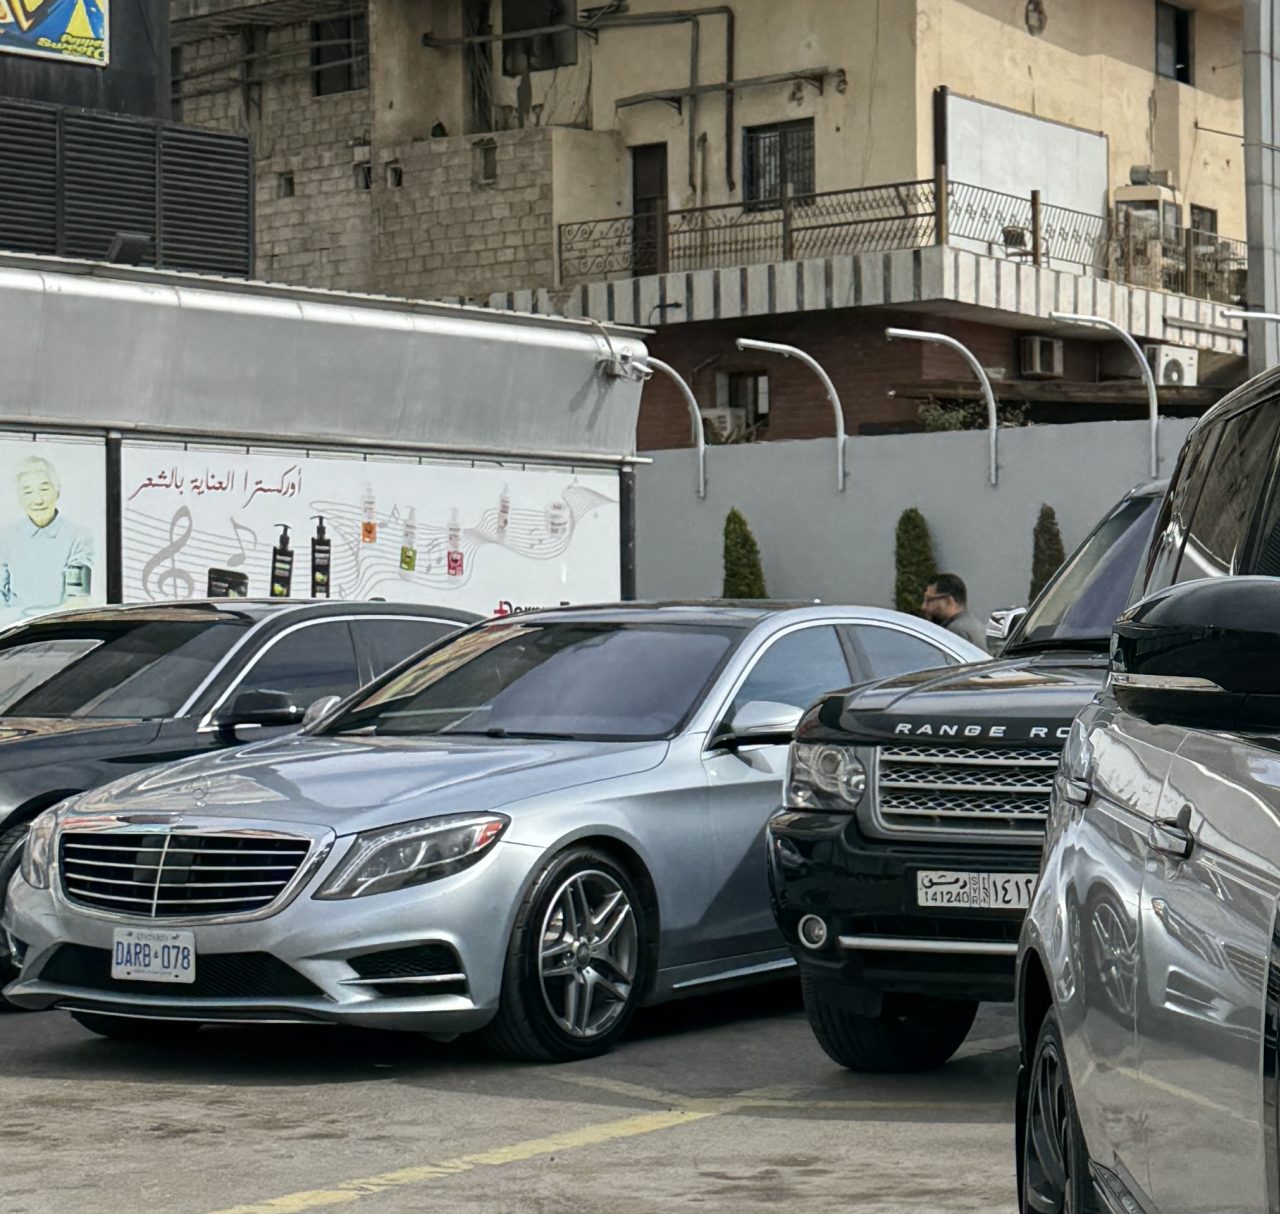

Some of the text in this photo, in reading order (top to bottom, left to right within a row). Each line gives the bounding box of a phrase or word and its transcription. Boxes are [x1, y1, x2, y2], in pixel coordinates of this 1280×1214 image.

[128, 464, 302, 508] أوركسترا العناية بالشعر
[894, 723, 1006, 738] RANGE
[924, 890, 970, 904] 141240
